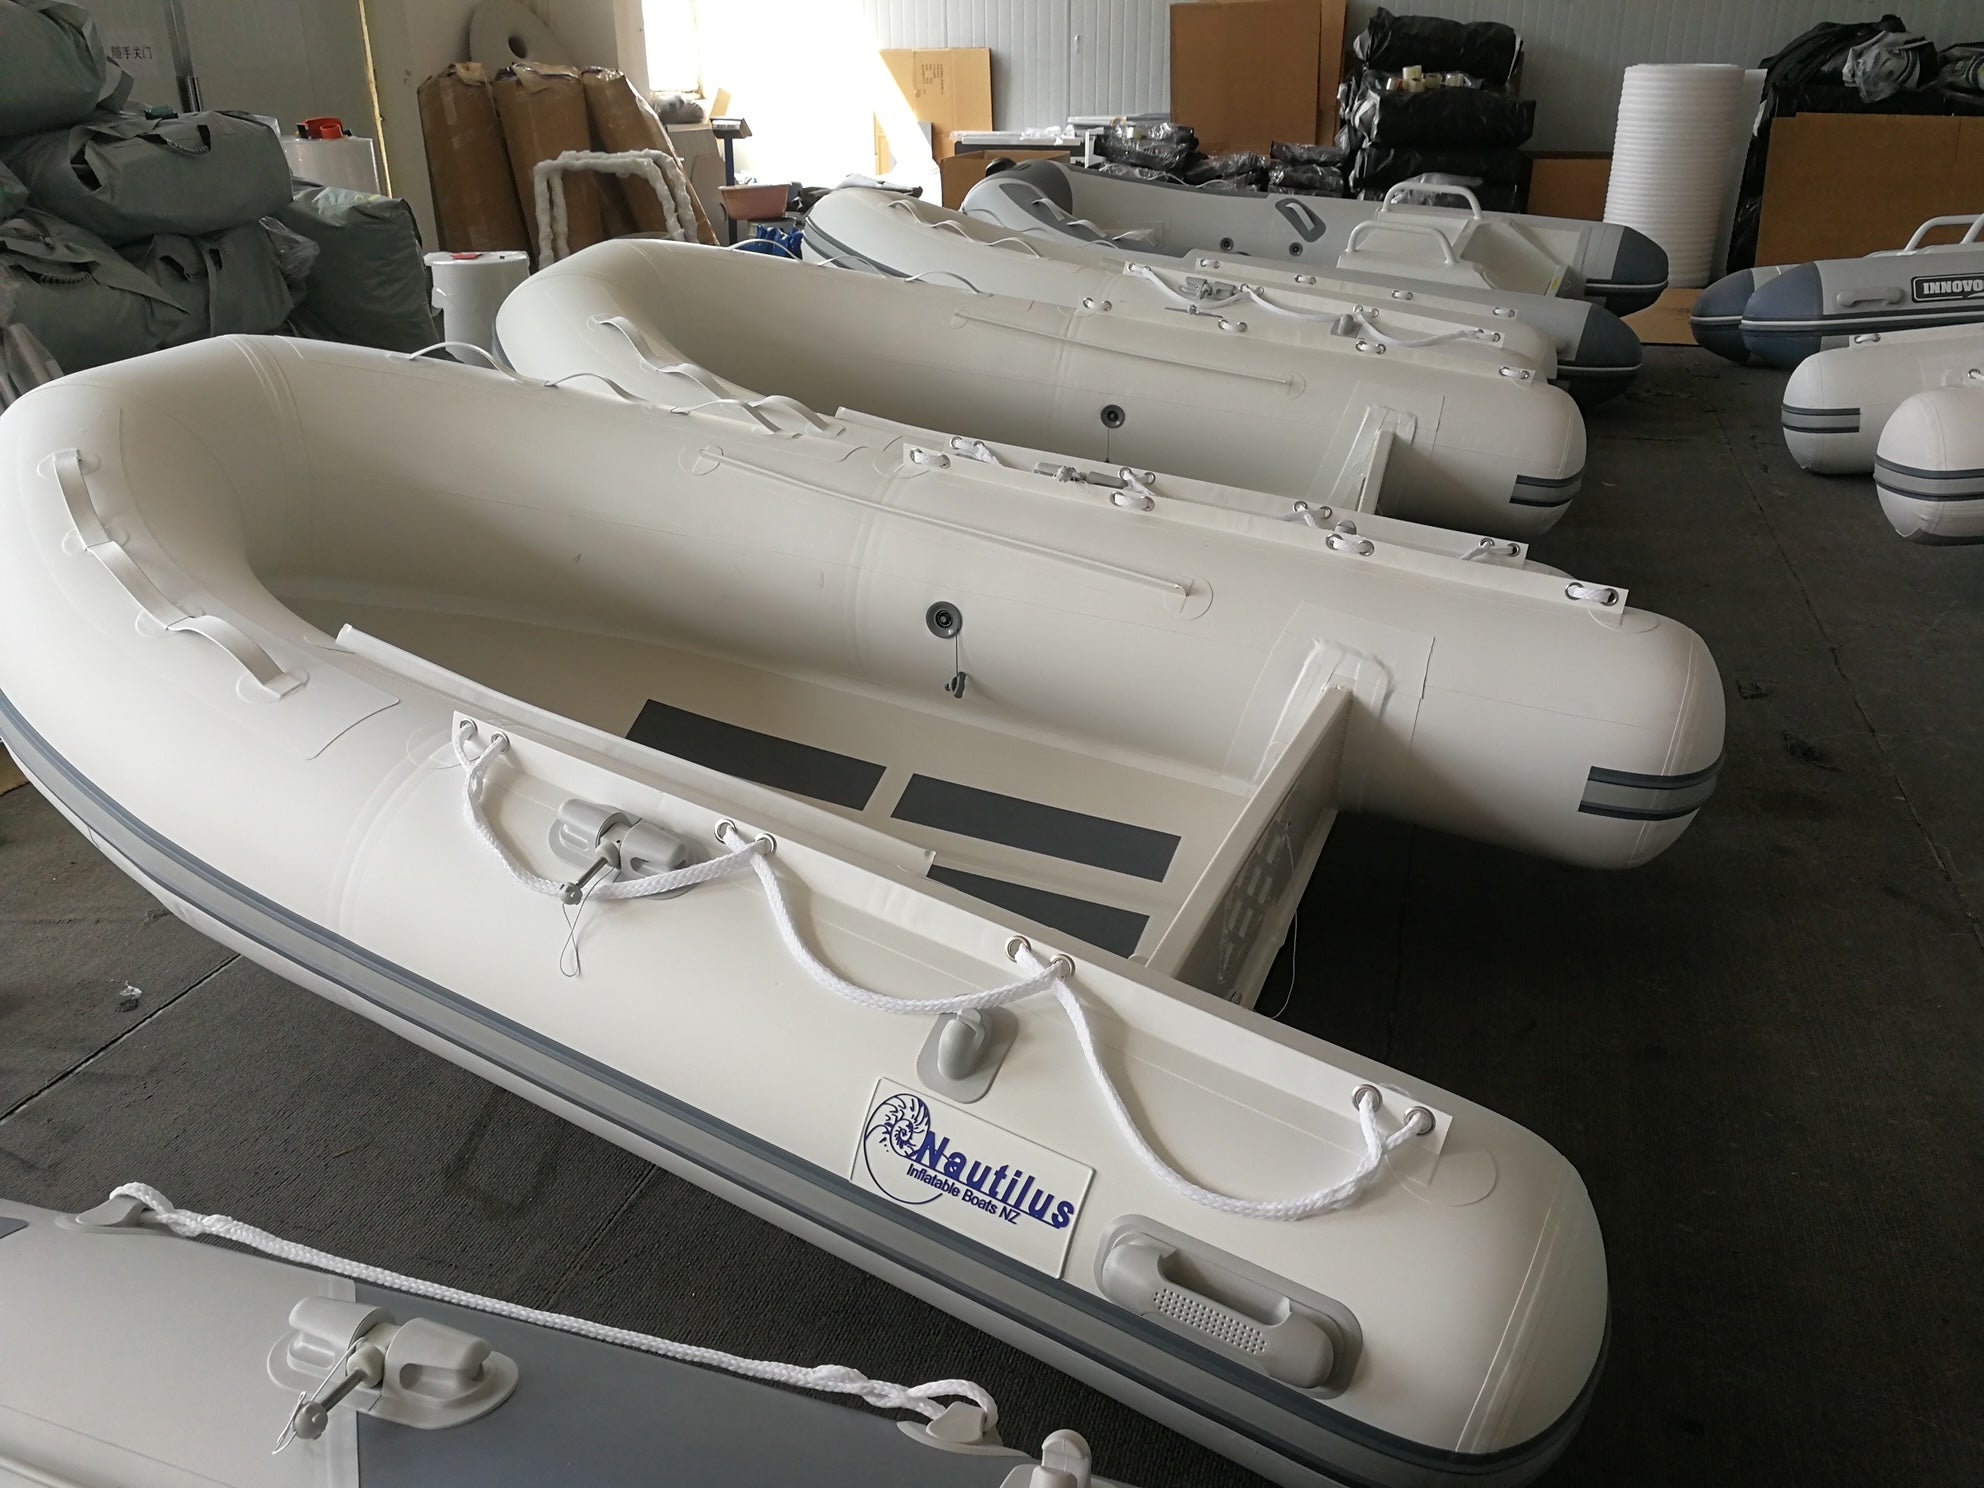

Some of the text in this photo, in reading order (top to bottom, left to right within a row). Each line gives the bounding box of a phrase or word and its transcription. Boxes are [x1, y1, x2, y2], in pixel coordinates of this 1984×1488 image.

[1923, 279, 1984, 294] INNOVO
[906, 1163, 1021, 1225] Inflatable Boats NZ
[914, 1130, 1075, 1229] Nautilus
